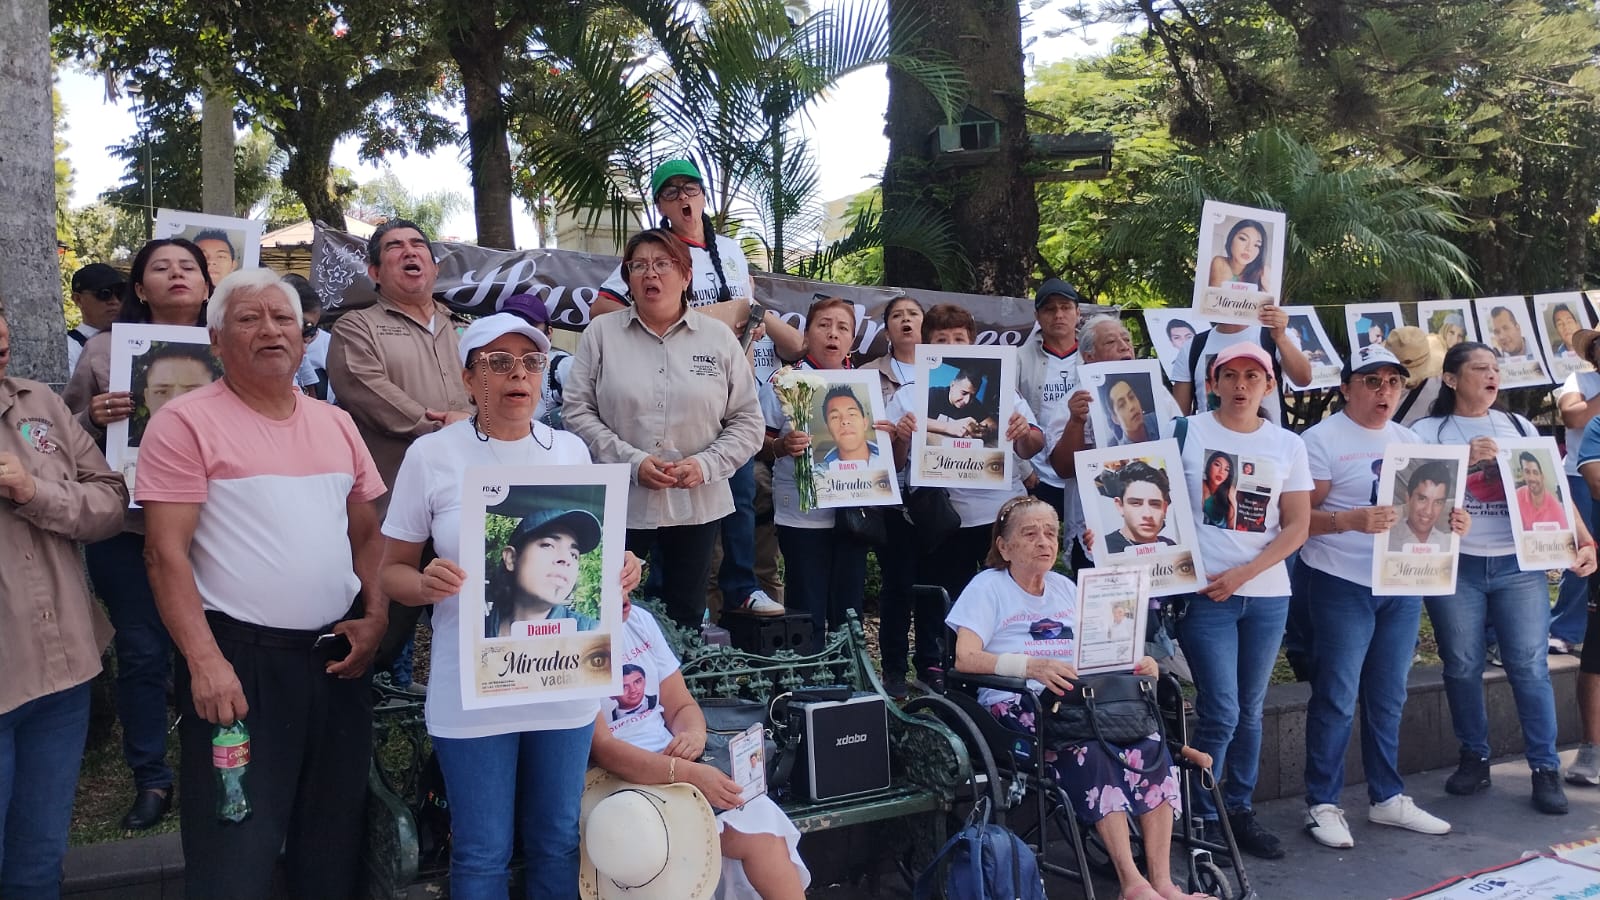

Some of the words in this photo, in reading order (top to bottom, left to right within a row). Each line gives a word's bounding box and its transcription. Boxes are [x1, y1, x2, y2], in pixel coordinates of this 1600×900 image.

[1212, 295, 1258, 311] Miradas
[932, 455, 985, 471] Miradas
[826, 478, 873, 492] Miradas
[1392, 561, 1442, 577] Miradas
[527, 622, 561, 637] Daniel
[498, 650, 580, 677] Miradas
[835, 733, 867, 747] xdobo
